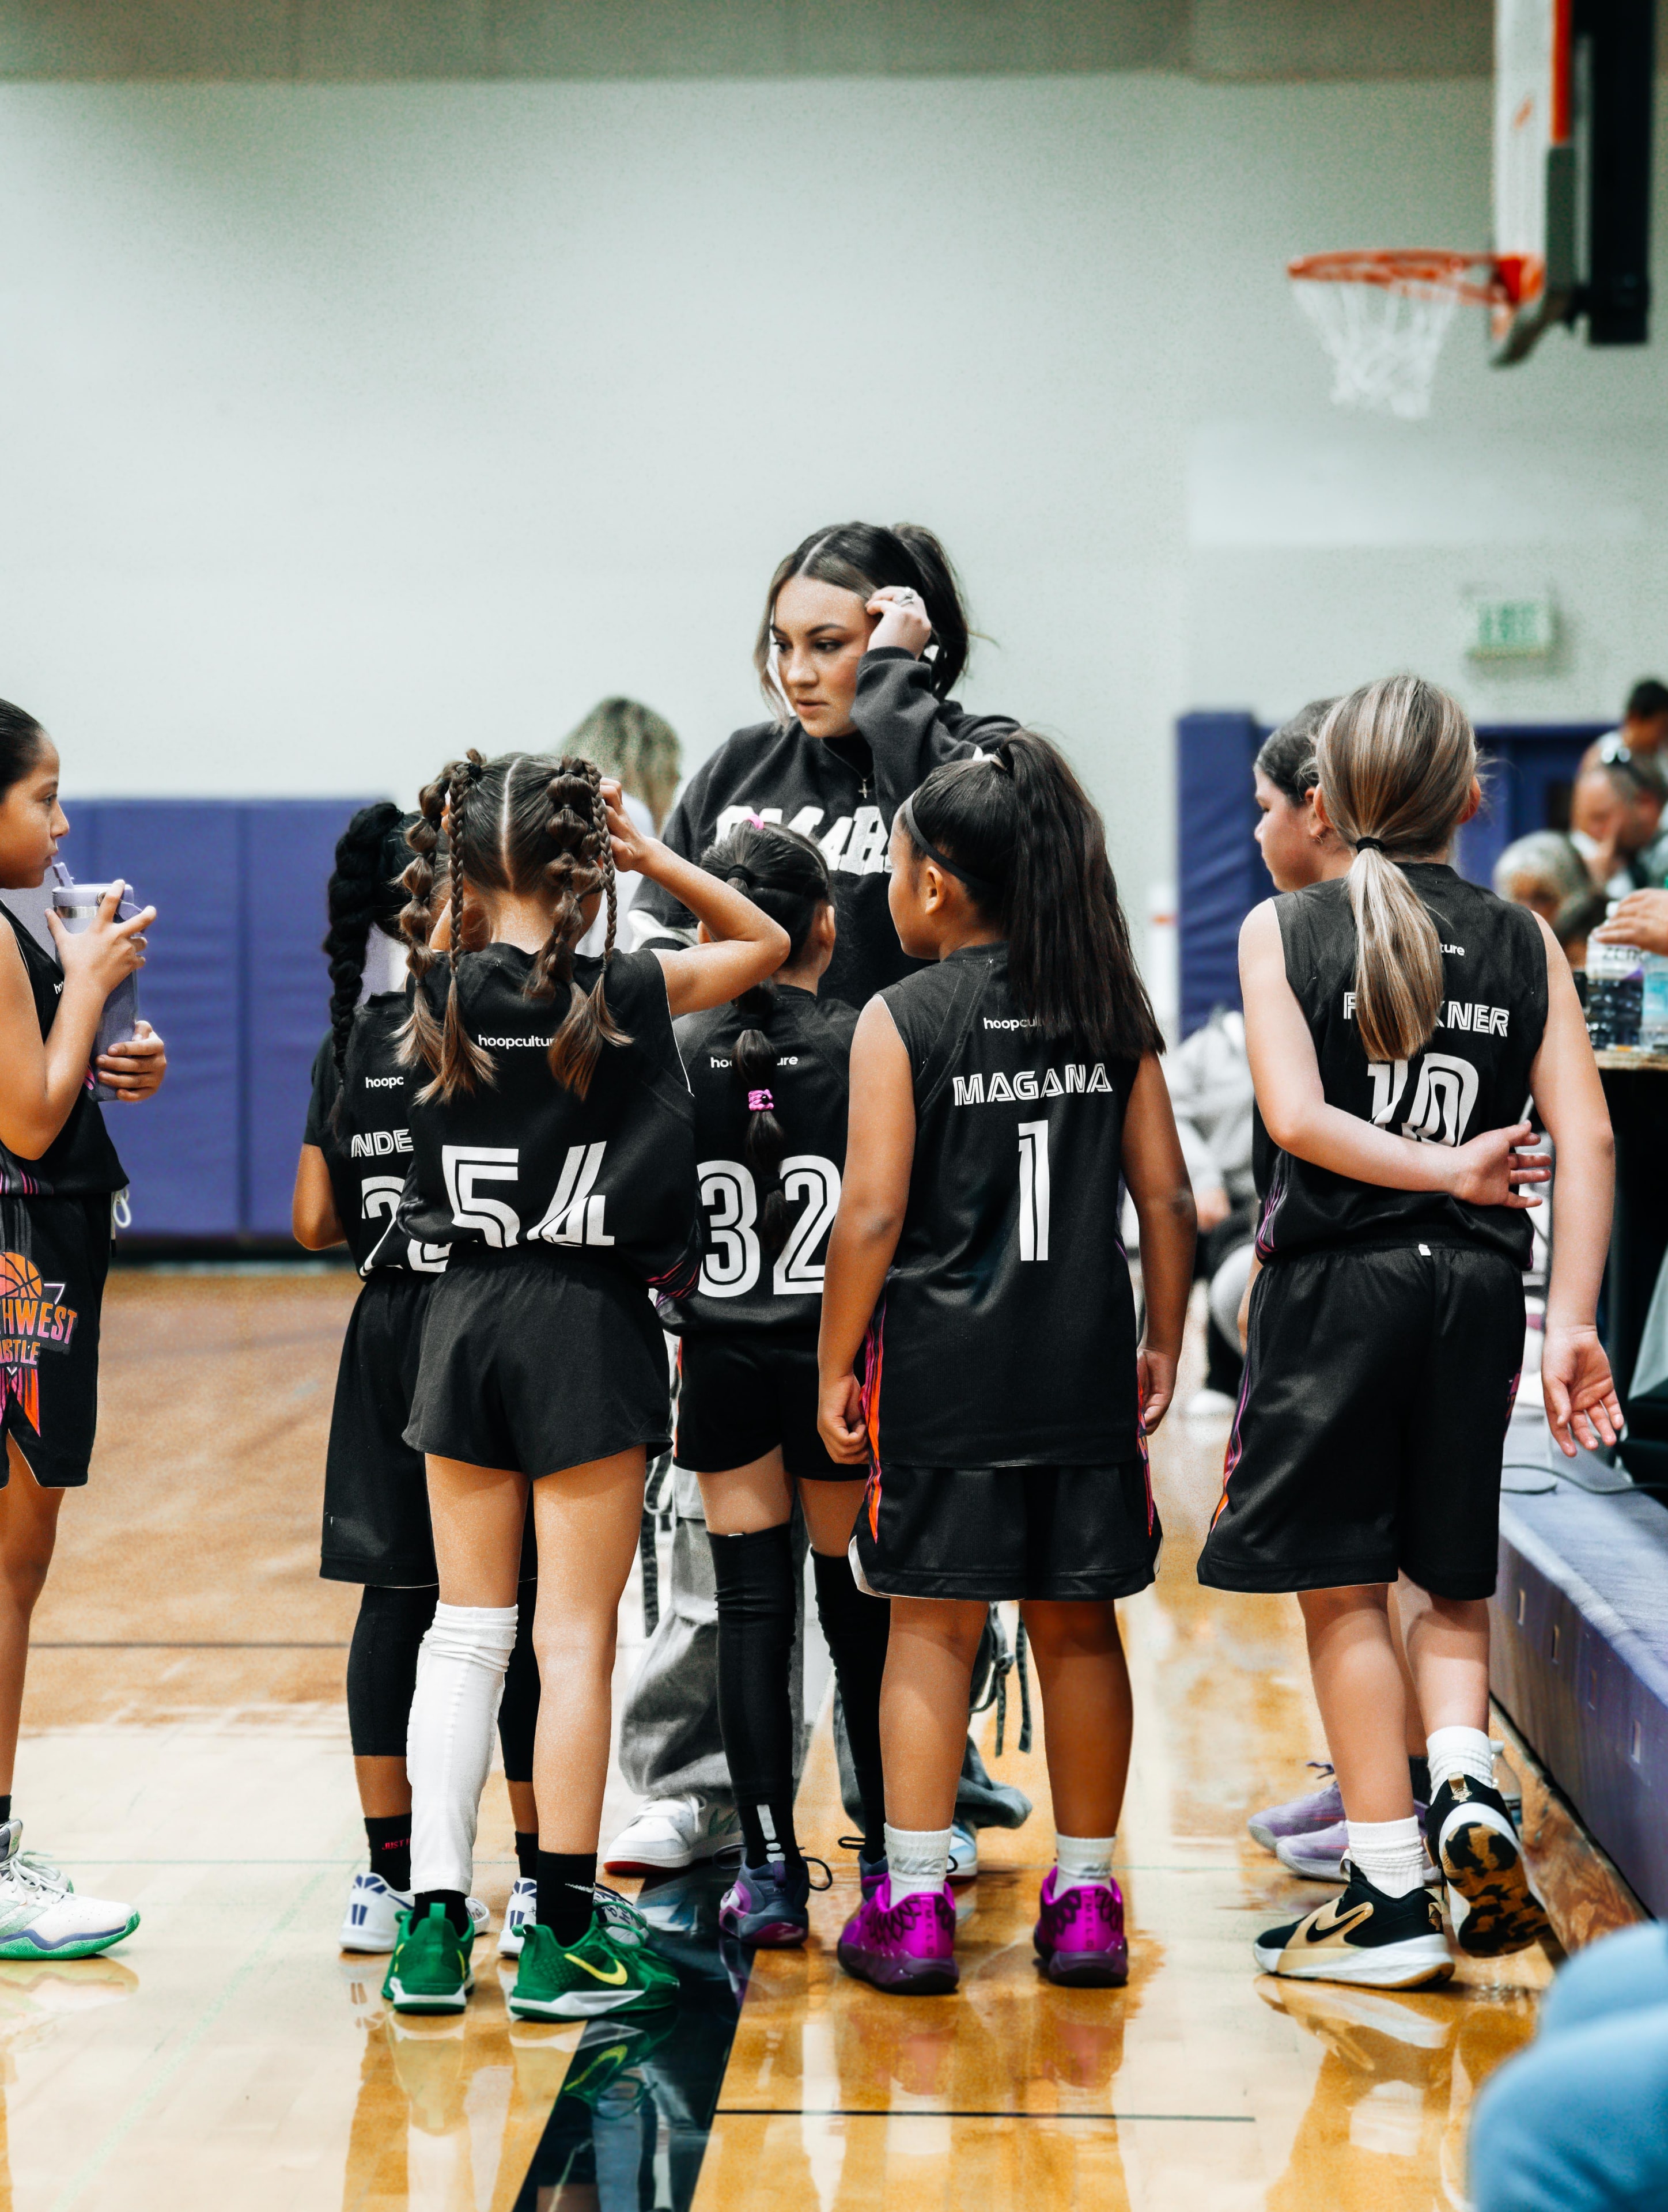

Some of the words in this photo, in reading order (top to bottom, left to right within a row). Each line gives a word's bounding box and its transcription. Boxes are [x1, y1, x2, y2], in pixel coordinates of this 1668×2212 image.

[952, 1063, 1113, 1106] MAGANA
[442, 1141, 615, 1248] 54
[697, 1155, 842, 1298] 32
[1018, 1120, 1050, 1261] 1
